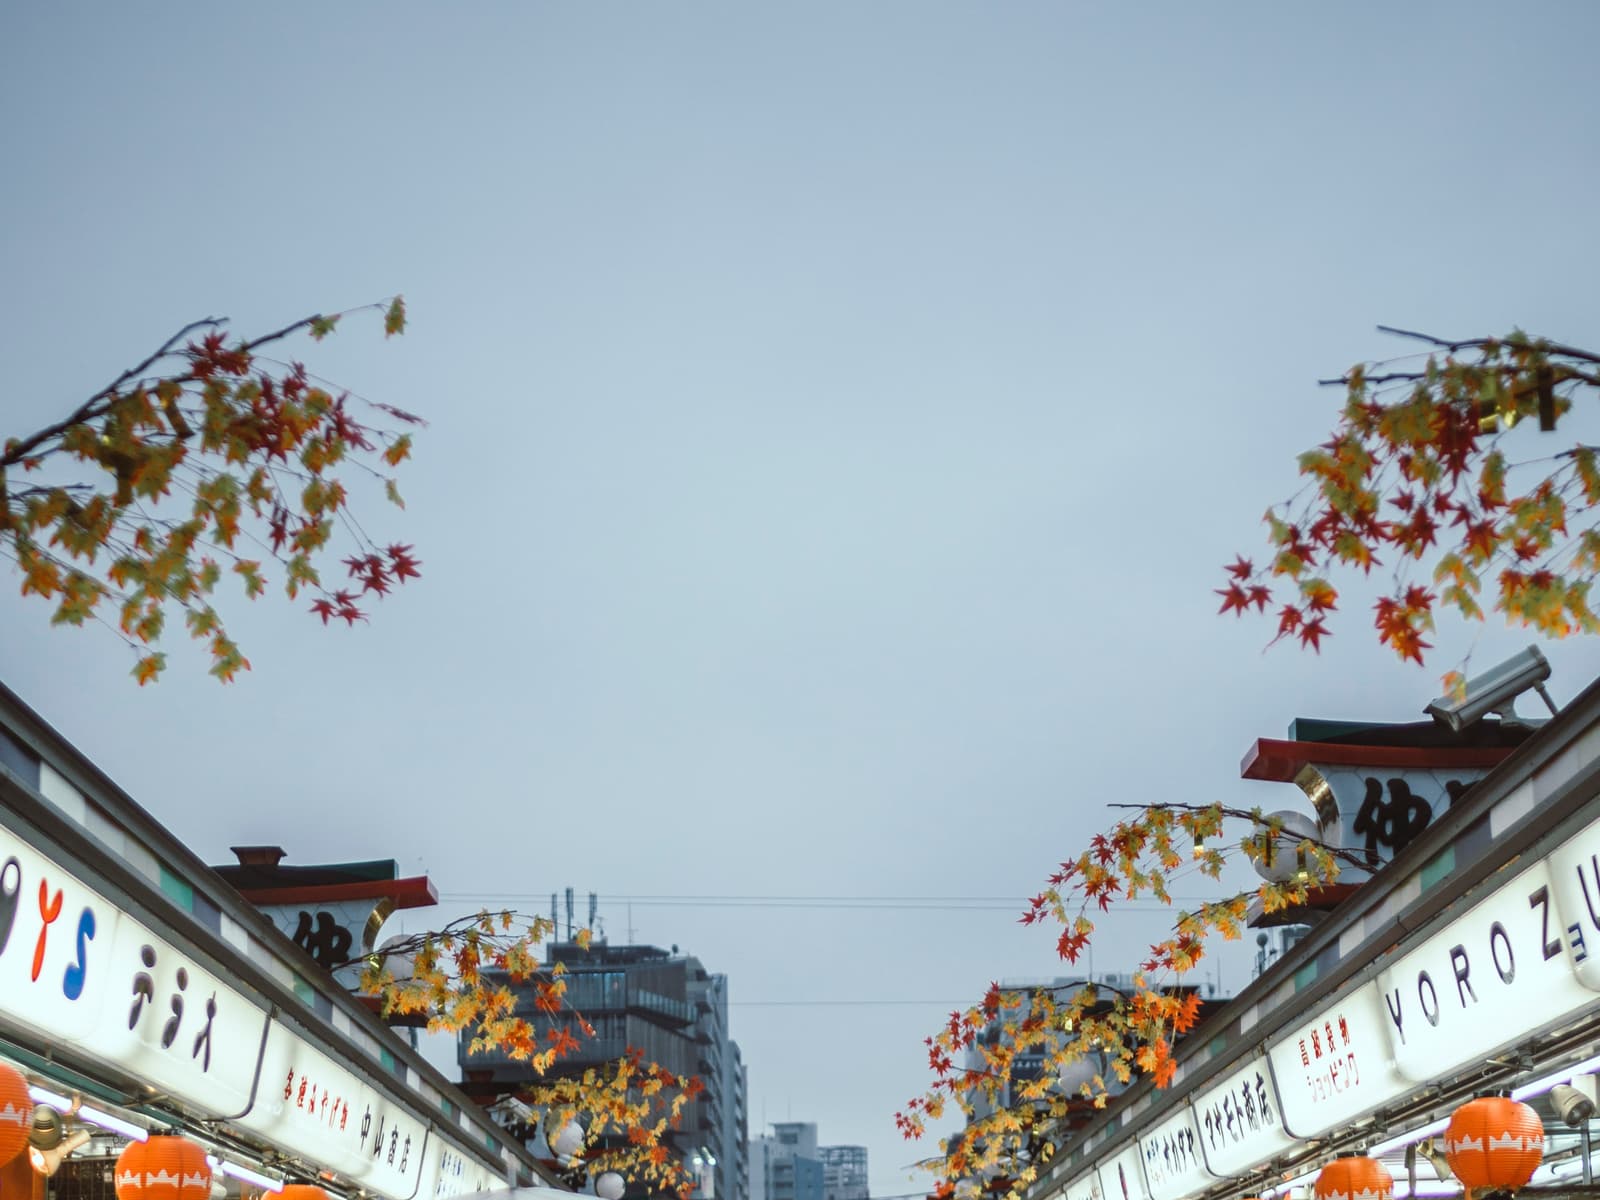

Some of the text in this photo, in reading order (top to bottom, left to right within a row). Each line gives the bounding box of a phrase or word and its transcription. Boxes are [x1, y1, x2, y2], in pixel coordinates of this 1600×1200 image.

[1353, 776, 1481, 866] 仲
[360, 1103, 411, 1175] 中山商店
